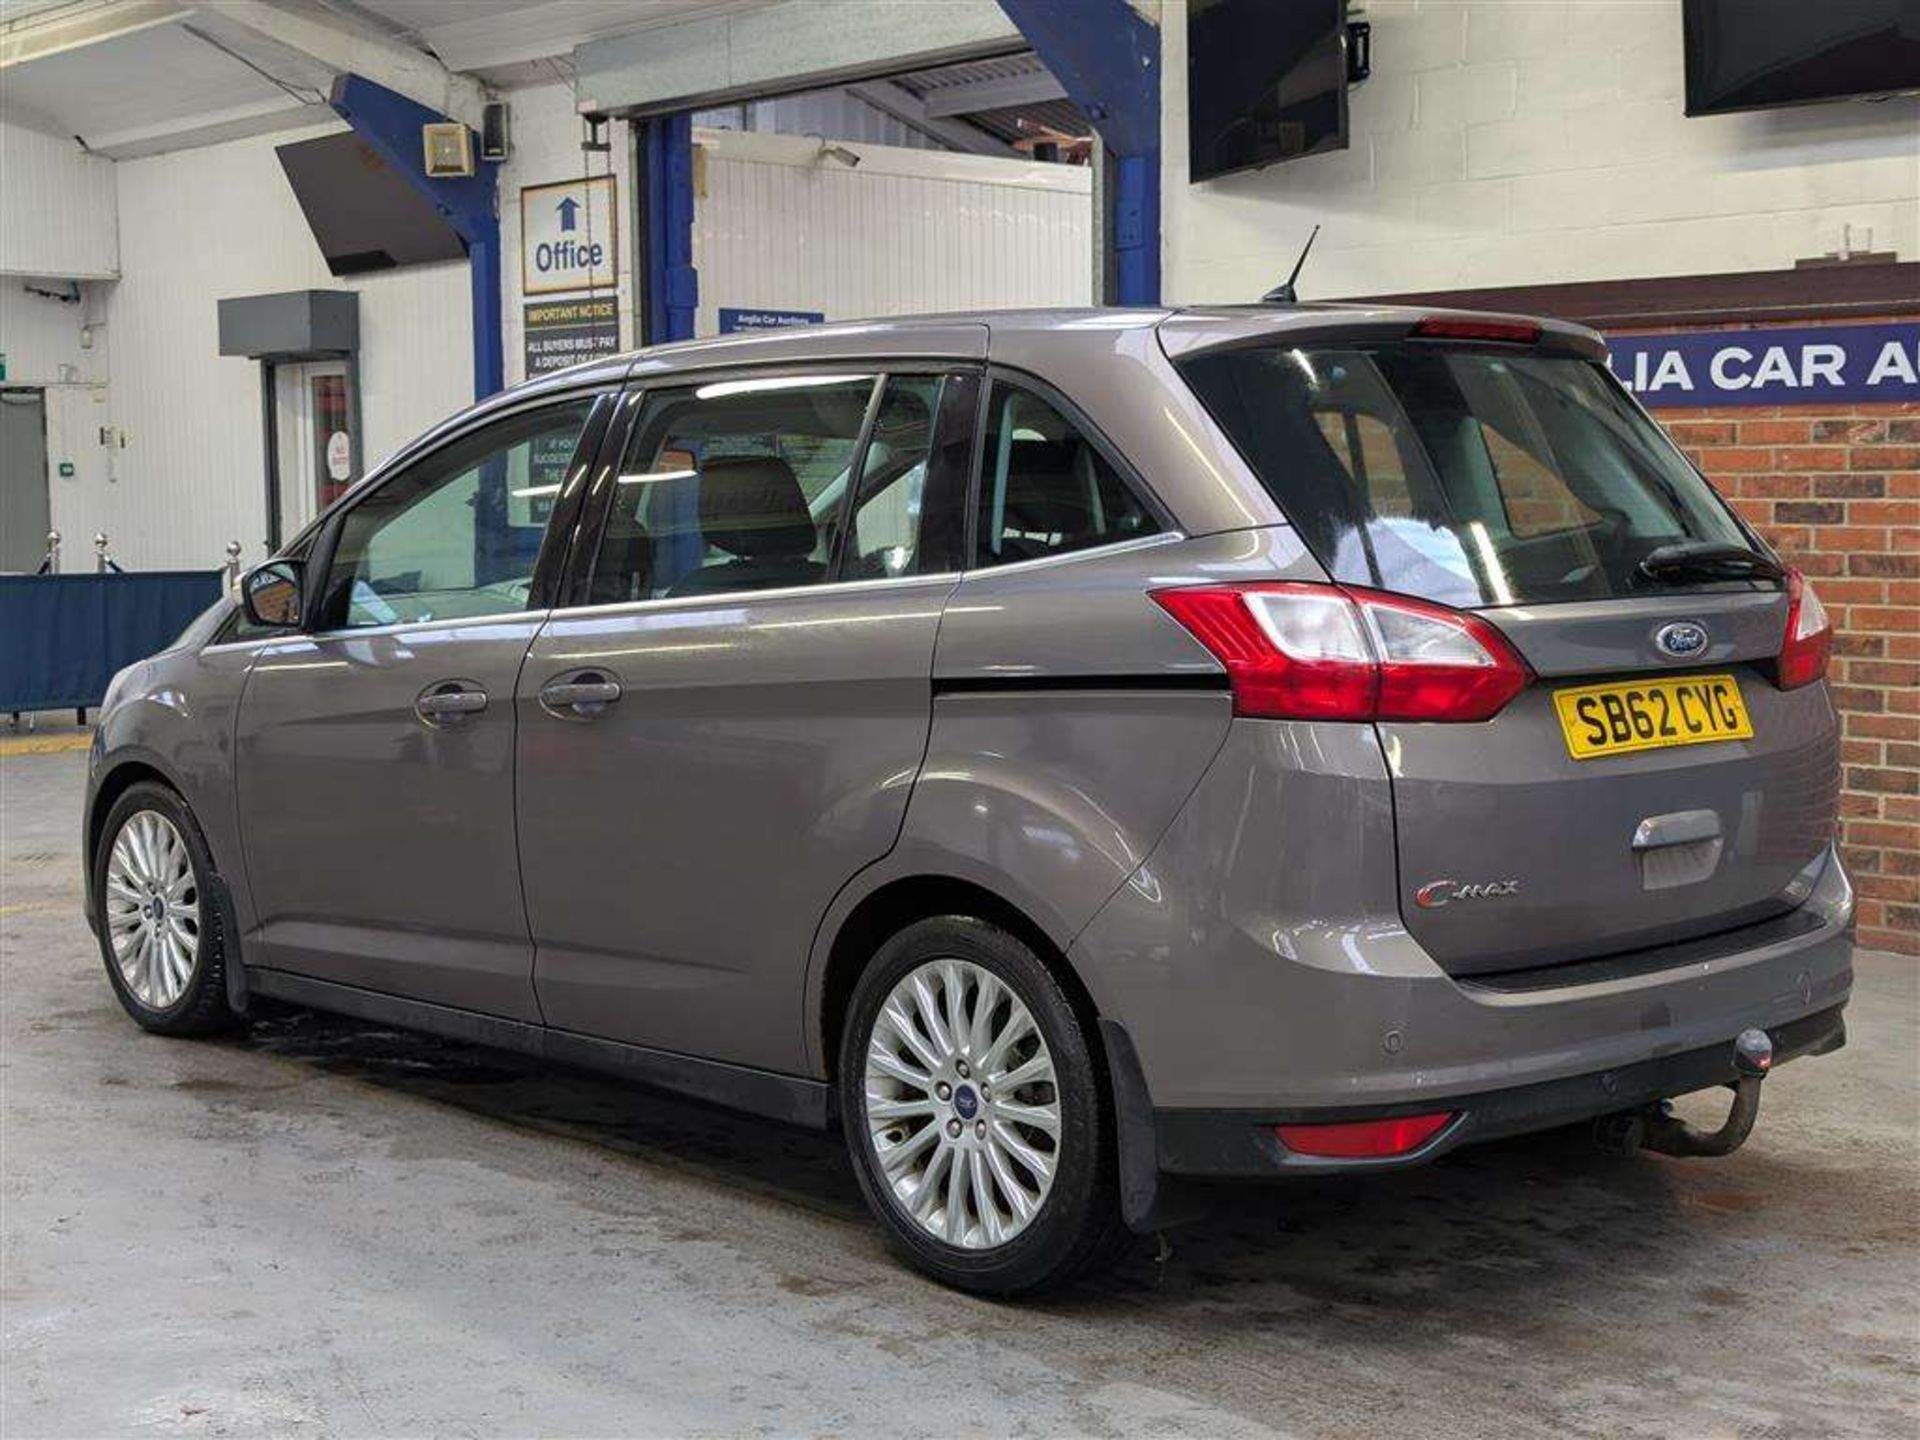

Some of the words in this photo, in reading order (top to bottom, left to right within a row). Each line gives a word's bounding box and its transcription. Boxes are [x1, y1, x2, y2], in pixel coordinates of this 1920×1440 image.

[536, 241, 603, 272] Office
[528, 305, 578, 322] IMPORTANT
[580, 302, 614, 318] NOTICE
[763, 315, 777, 324] Car
[528, 342, 542, 353] ALL
[543, 338, 574, 352] BUYERS
[599, 335, 616, 348] PAY
[1710, 344, 1846, 390] CAR
[1866, 340, 1920, 385] A
[1670, 630, 1699, 649] Ford
[1576, 689, 1678, 746] SB62
[1676, 684, 1737, 734] CYG
